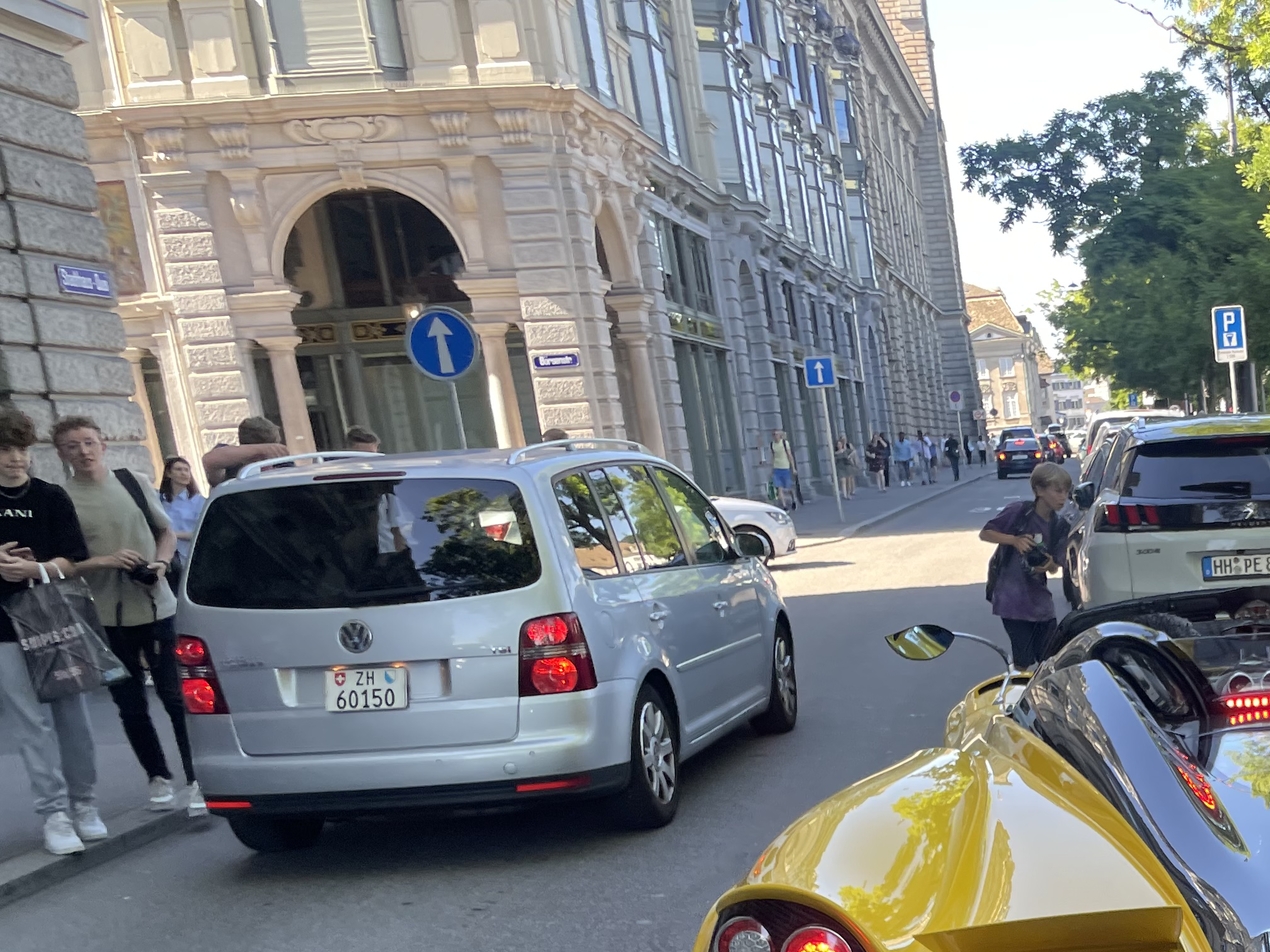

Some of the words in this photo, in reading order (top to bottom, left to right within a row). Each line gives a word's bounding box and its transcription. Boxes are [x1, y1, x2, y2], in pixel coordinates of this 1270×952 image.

[1213, 559, 1232, 575] HH
[1244, 557, 1261, 574] PE
[355, 671, 375, 686] ZH
[336, 688, 396, 710] 60150
